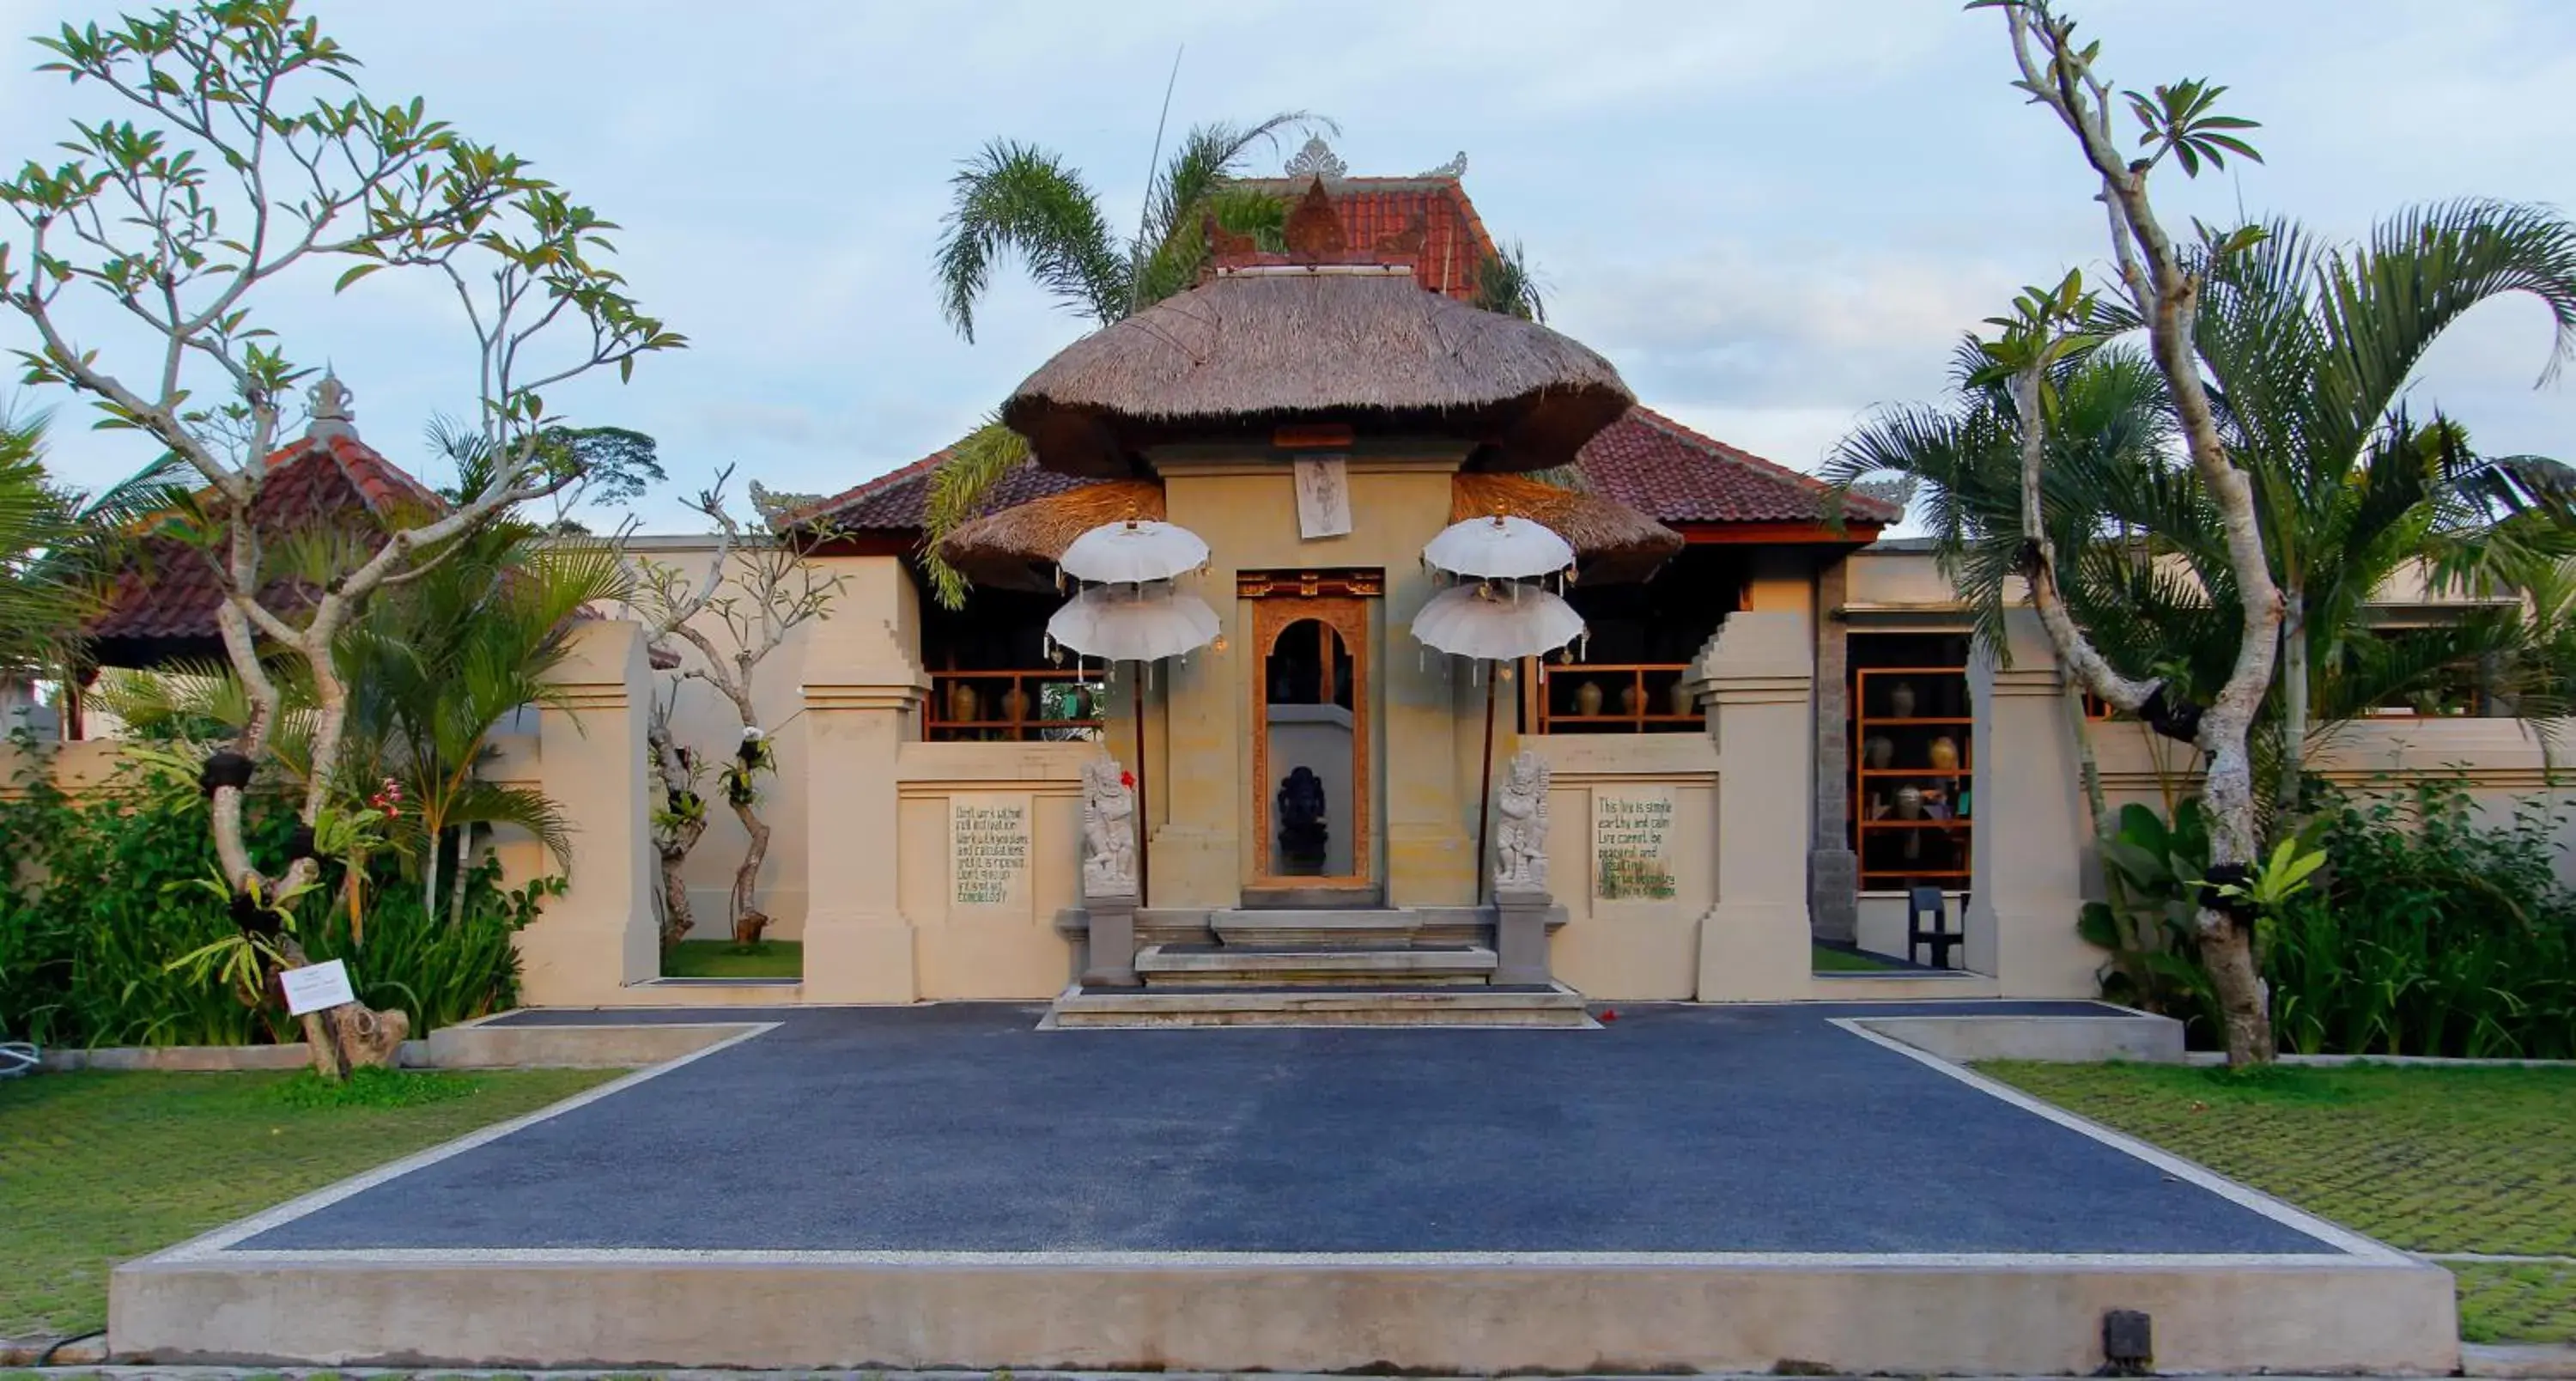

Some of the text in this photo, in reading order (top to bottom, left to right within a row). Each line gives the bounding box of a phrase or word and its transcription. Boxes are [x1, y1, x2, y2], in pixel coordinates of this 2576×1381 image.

[1598, 797, 1618, 813] This
[1636, 800, 1643, 813] is
[1634, 815, 1648, 828] and
